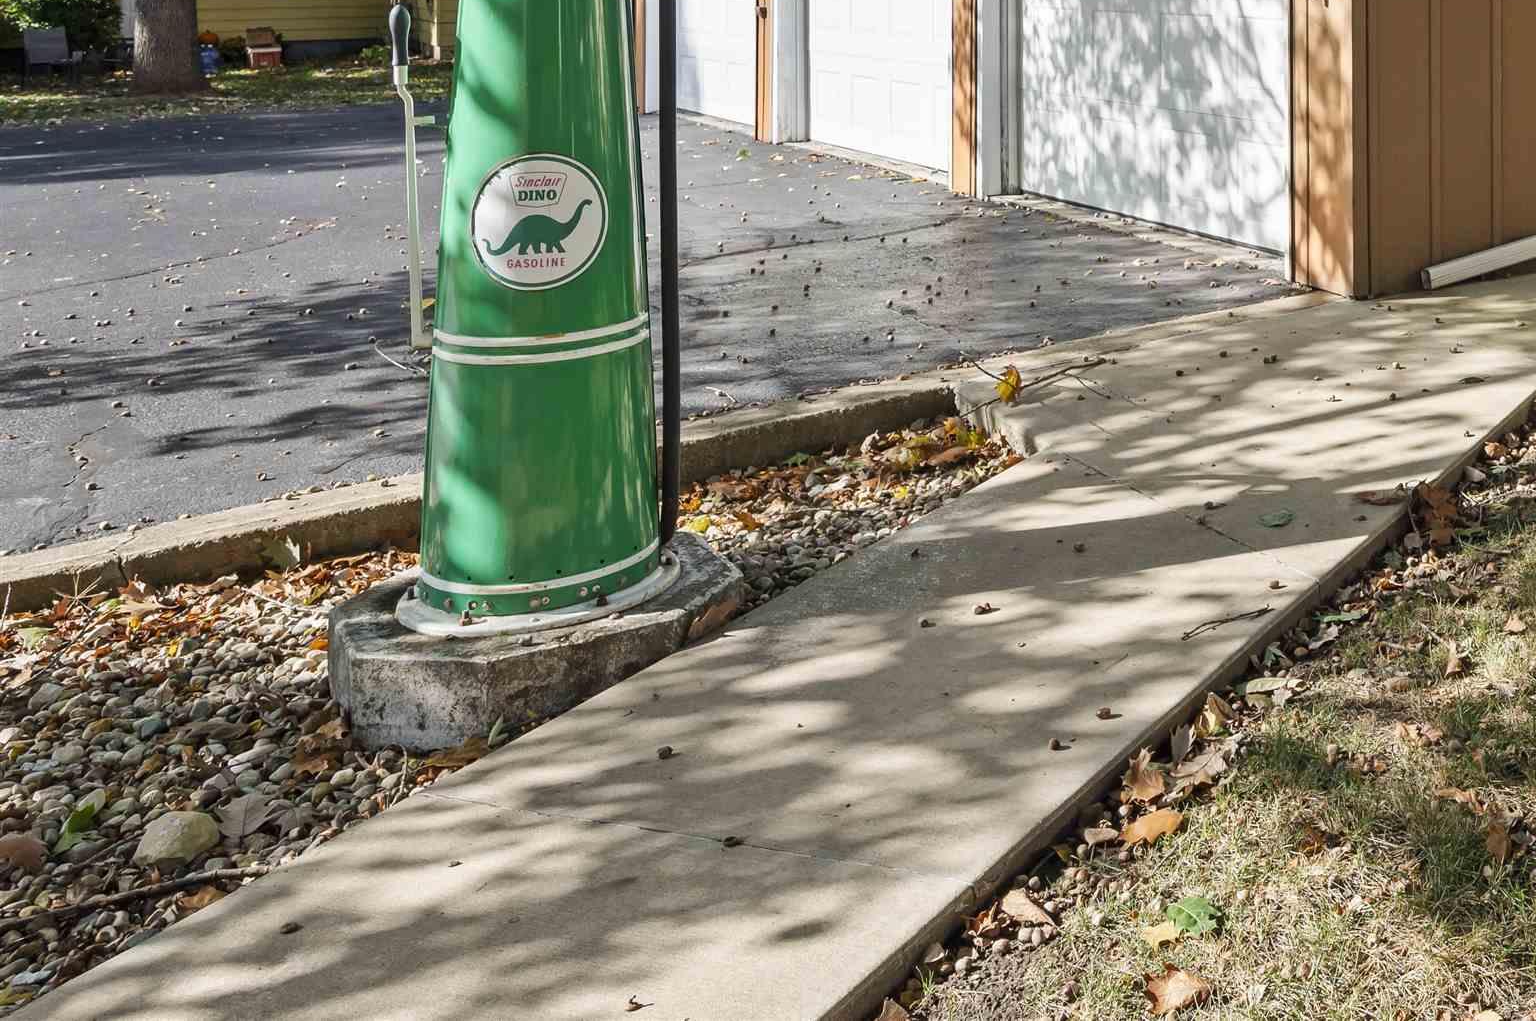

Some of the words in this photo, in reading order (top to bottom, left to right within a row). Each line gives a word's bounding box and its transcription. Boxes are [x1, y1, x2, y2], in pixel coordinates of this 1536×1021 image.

[515, 175, 561, 188] Sinclair
[517, 189, 558, 202] DINO
[506, 257, 566, 269] GASOLINE
